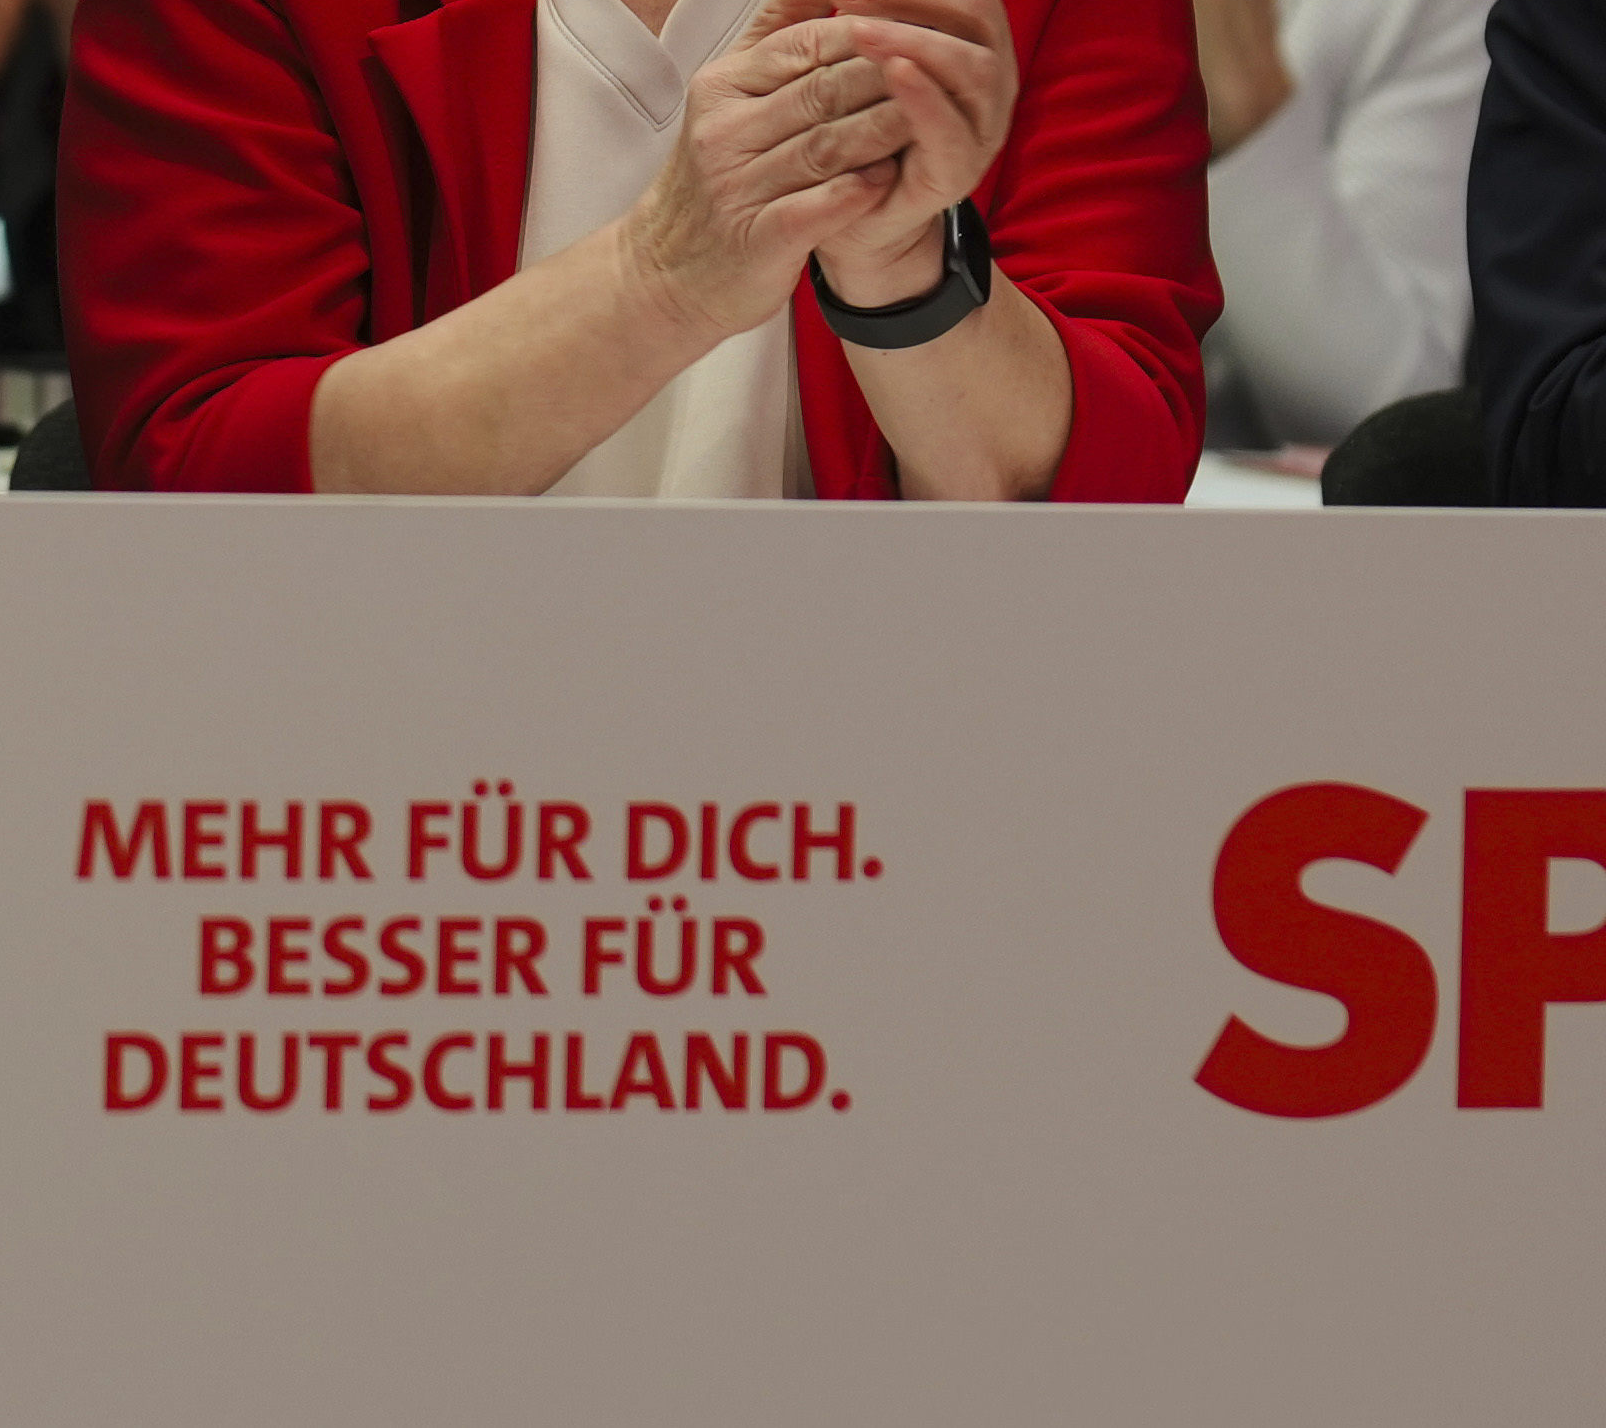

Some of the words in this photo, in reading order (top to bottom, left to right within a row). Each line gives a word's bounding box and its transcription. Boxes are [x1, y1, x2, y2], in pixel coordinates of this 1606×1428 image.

[77, 800, 373, 882] MEHR
[407, 780, 592, 882] FÜR
[625, 802, 884, 883] DICH.
[199, 915, 550, 997] BESSER
[583, 895, 768, 998] FÜR
[104, 1031, 852, 1113] DEUTSCHLAND.
